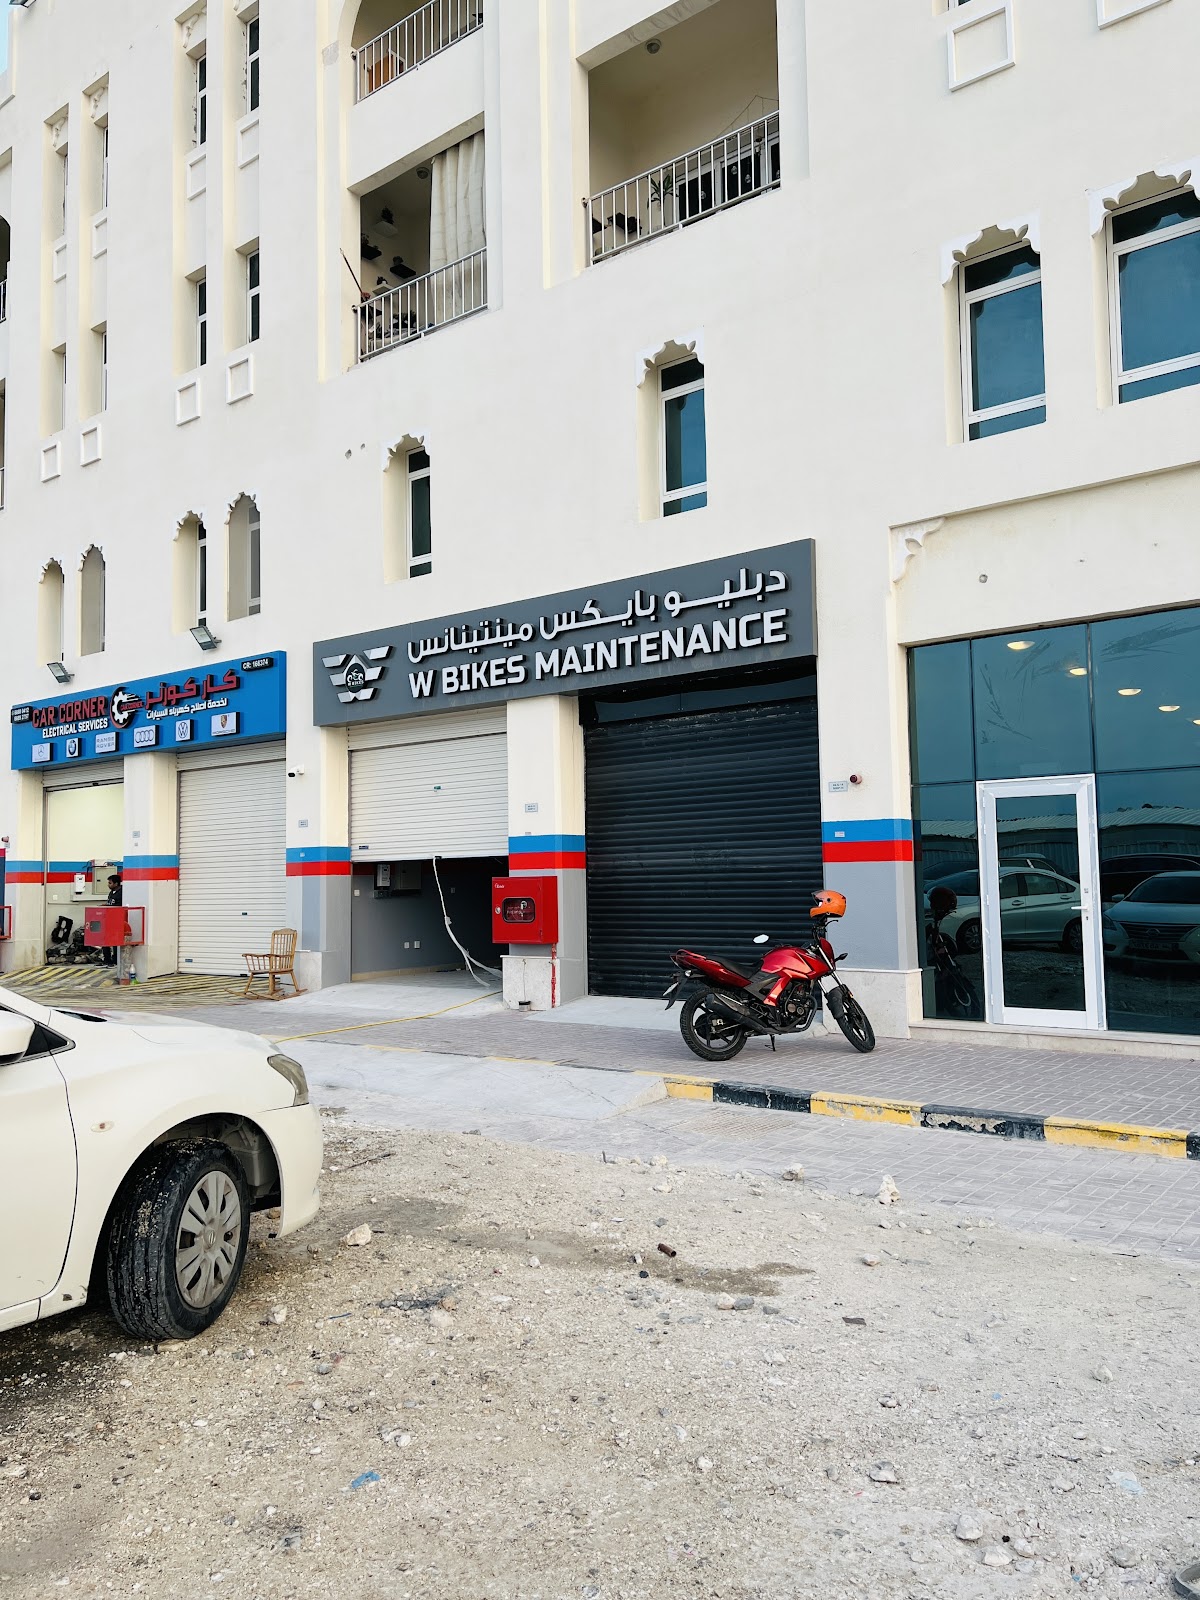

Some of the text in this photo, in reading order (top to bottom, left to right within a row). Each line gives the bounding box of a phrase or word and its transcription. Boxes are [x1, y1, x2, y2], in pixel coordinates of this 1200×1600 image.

[407, 567, 788, 664] دبليو بايكس مينتينانس
[408, 607, 788, 698] W BIKES MAINTENANCE
[202, 669, 238, 700] كار
[32, 696, 107, 727] CAR CORNER
[42, 718, 108, 739] ELECTRICAL SERVICES
